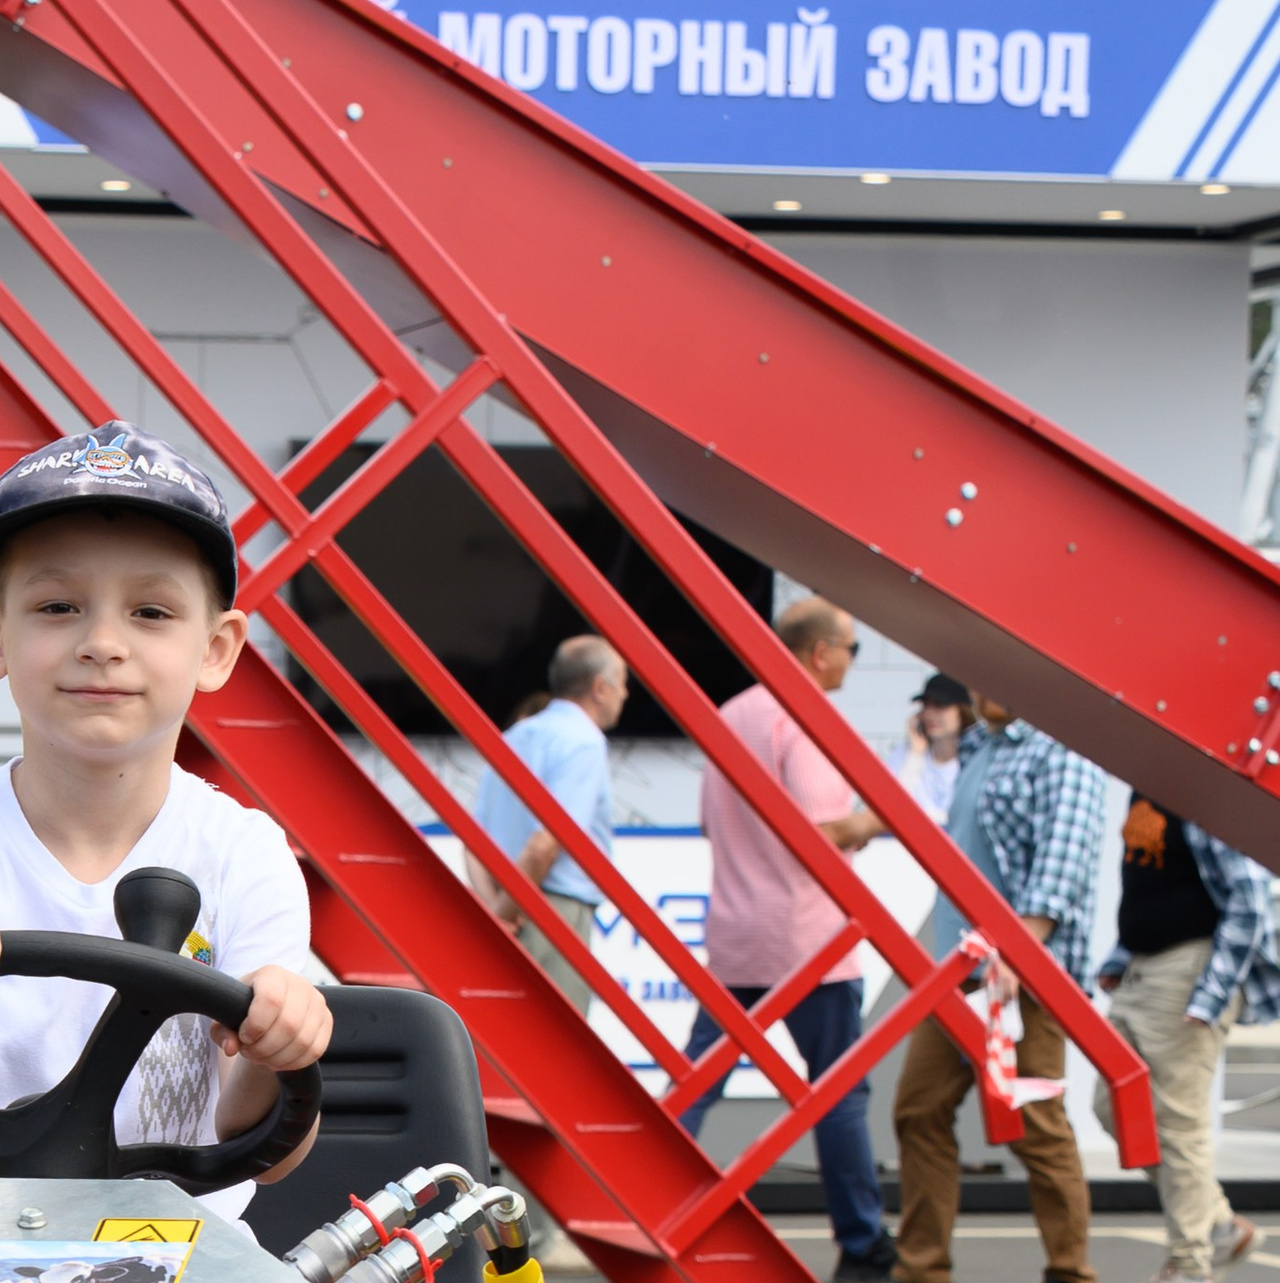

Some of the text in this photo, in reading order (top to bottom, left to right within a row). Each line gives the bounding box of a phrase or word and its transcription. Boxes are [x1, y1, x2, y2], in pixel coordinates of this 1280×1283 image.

[437, 8, 1091, 118] МОТОРНЫЙ ЗАВОД
[17, 447, 87, 478] SHARK
